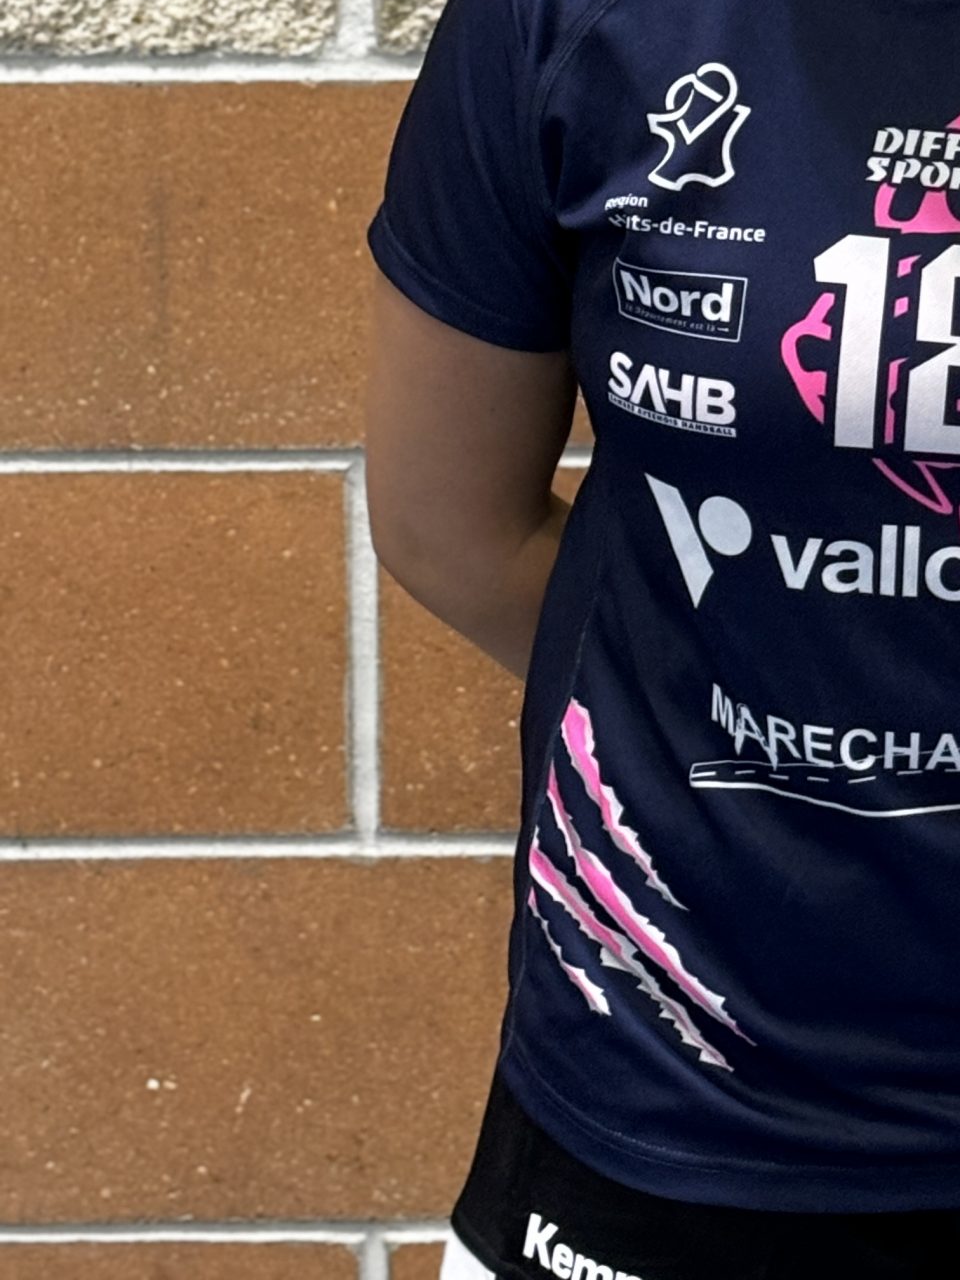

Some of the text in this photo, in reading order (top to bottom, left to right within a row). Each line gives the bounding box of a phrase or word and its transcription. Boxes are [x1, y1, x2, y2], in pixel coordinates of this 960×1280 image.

[619, 269, 734, 323] Nord
[608, 351, 737, 426] SAHB
[522, 1212, 643, 1280] Kem
